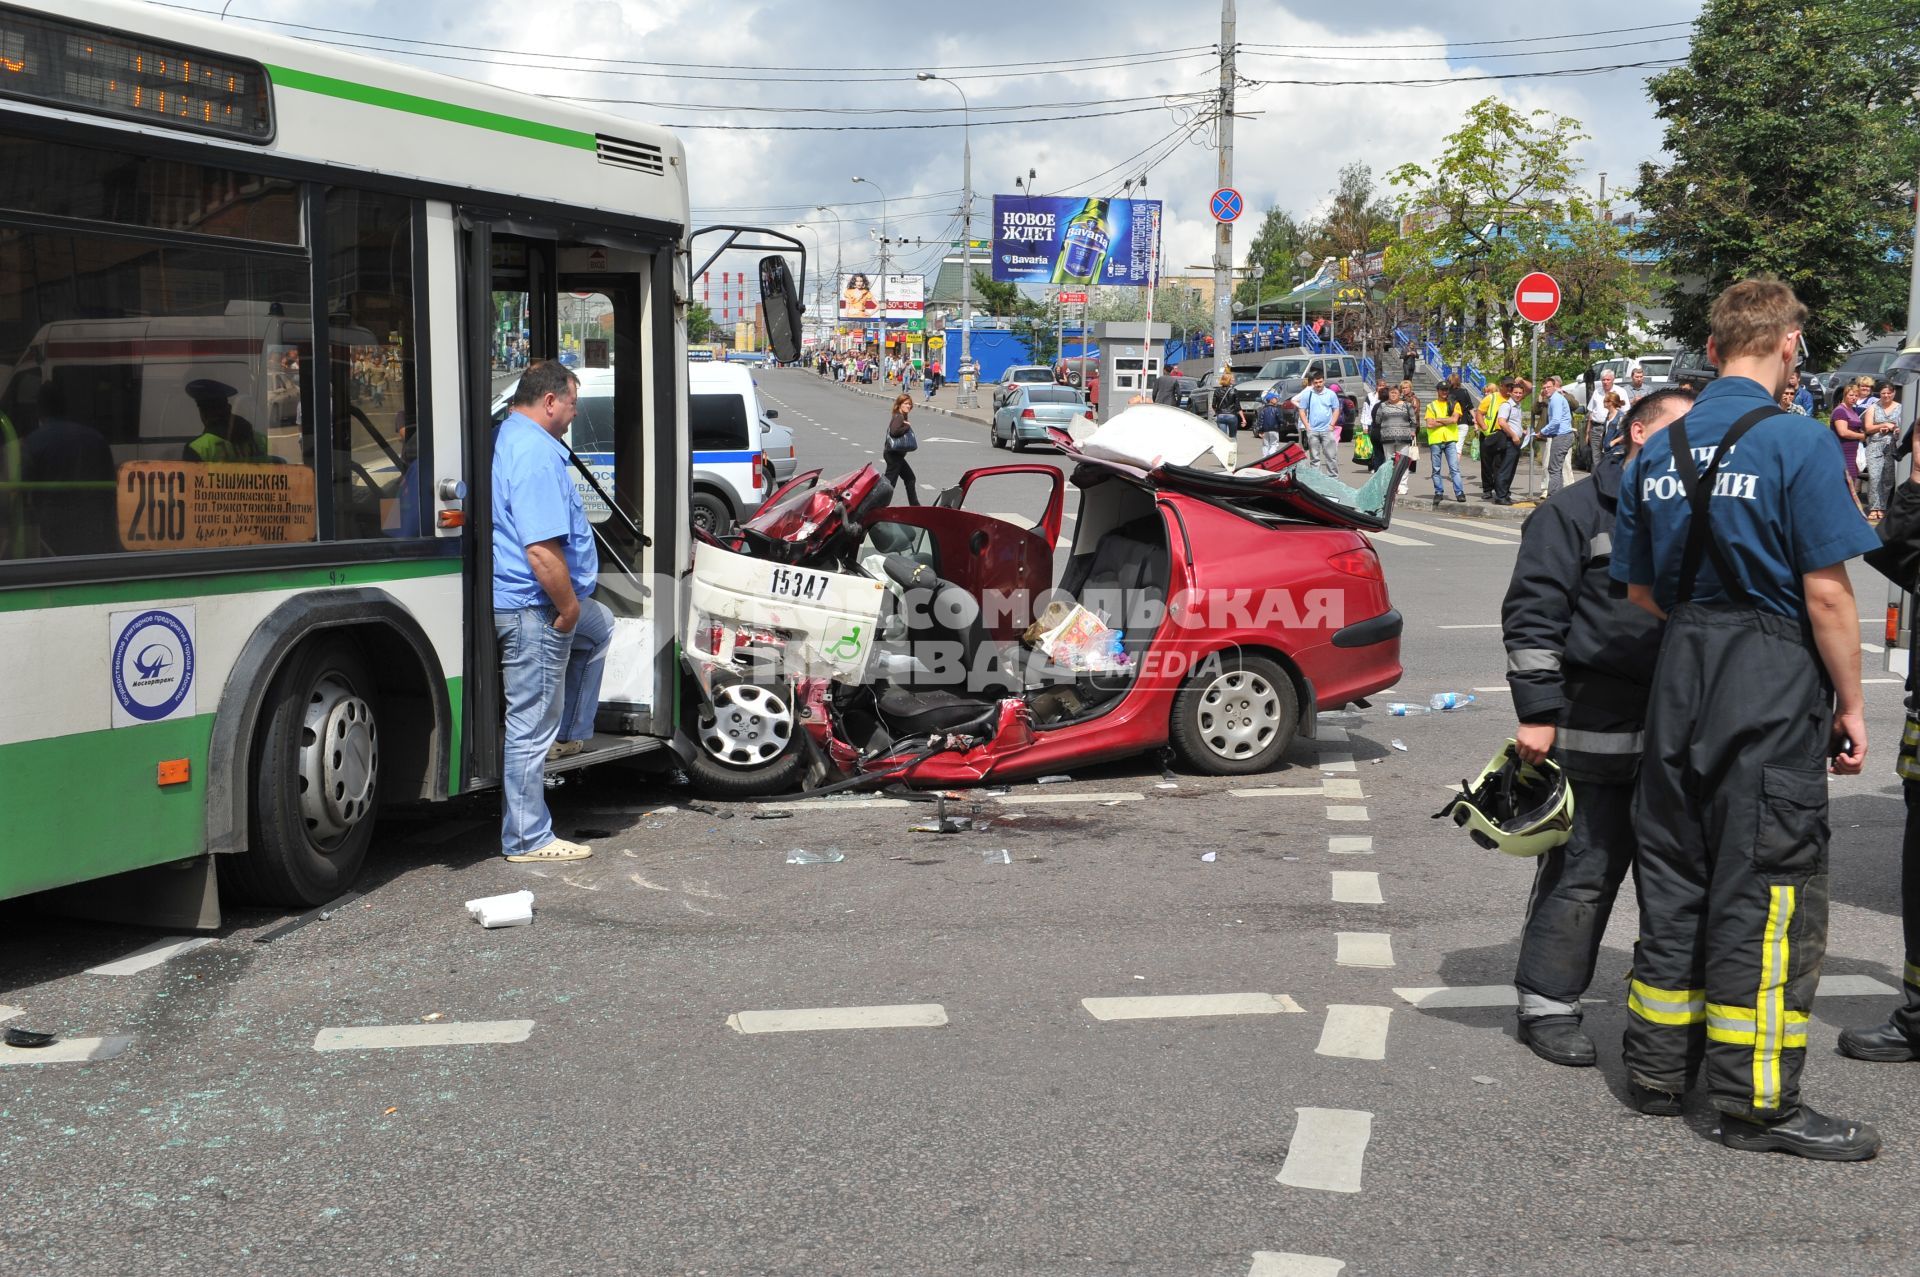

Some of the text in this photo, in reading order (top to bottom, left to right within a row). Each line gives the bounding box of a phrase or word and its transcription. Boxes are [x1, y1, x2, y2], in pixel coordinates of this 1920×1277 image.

[1003, 212, 1056, 226] НОВОЕ
[1002, 226, 1056, 243] ЖДЕТ
[1066, 227, 1108, 250] Bavaria
[1011, 255, 1049, 265] Bavaria
[127, 471, 185, 541] 266
[771, 568, 829, 601] 15347
